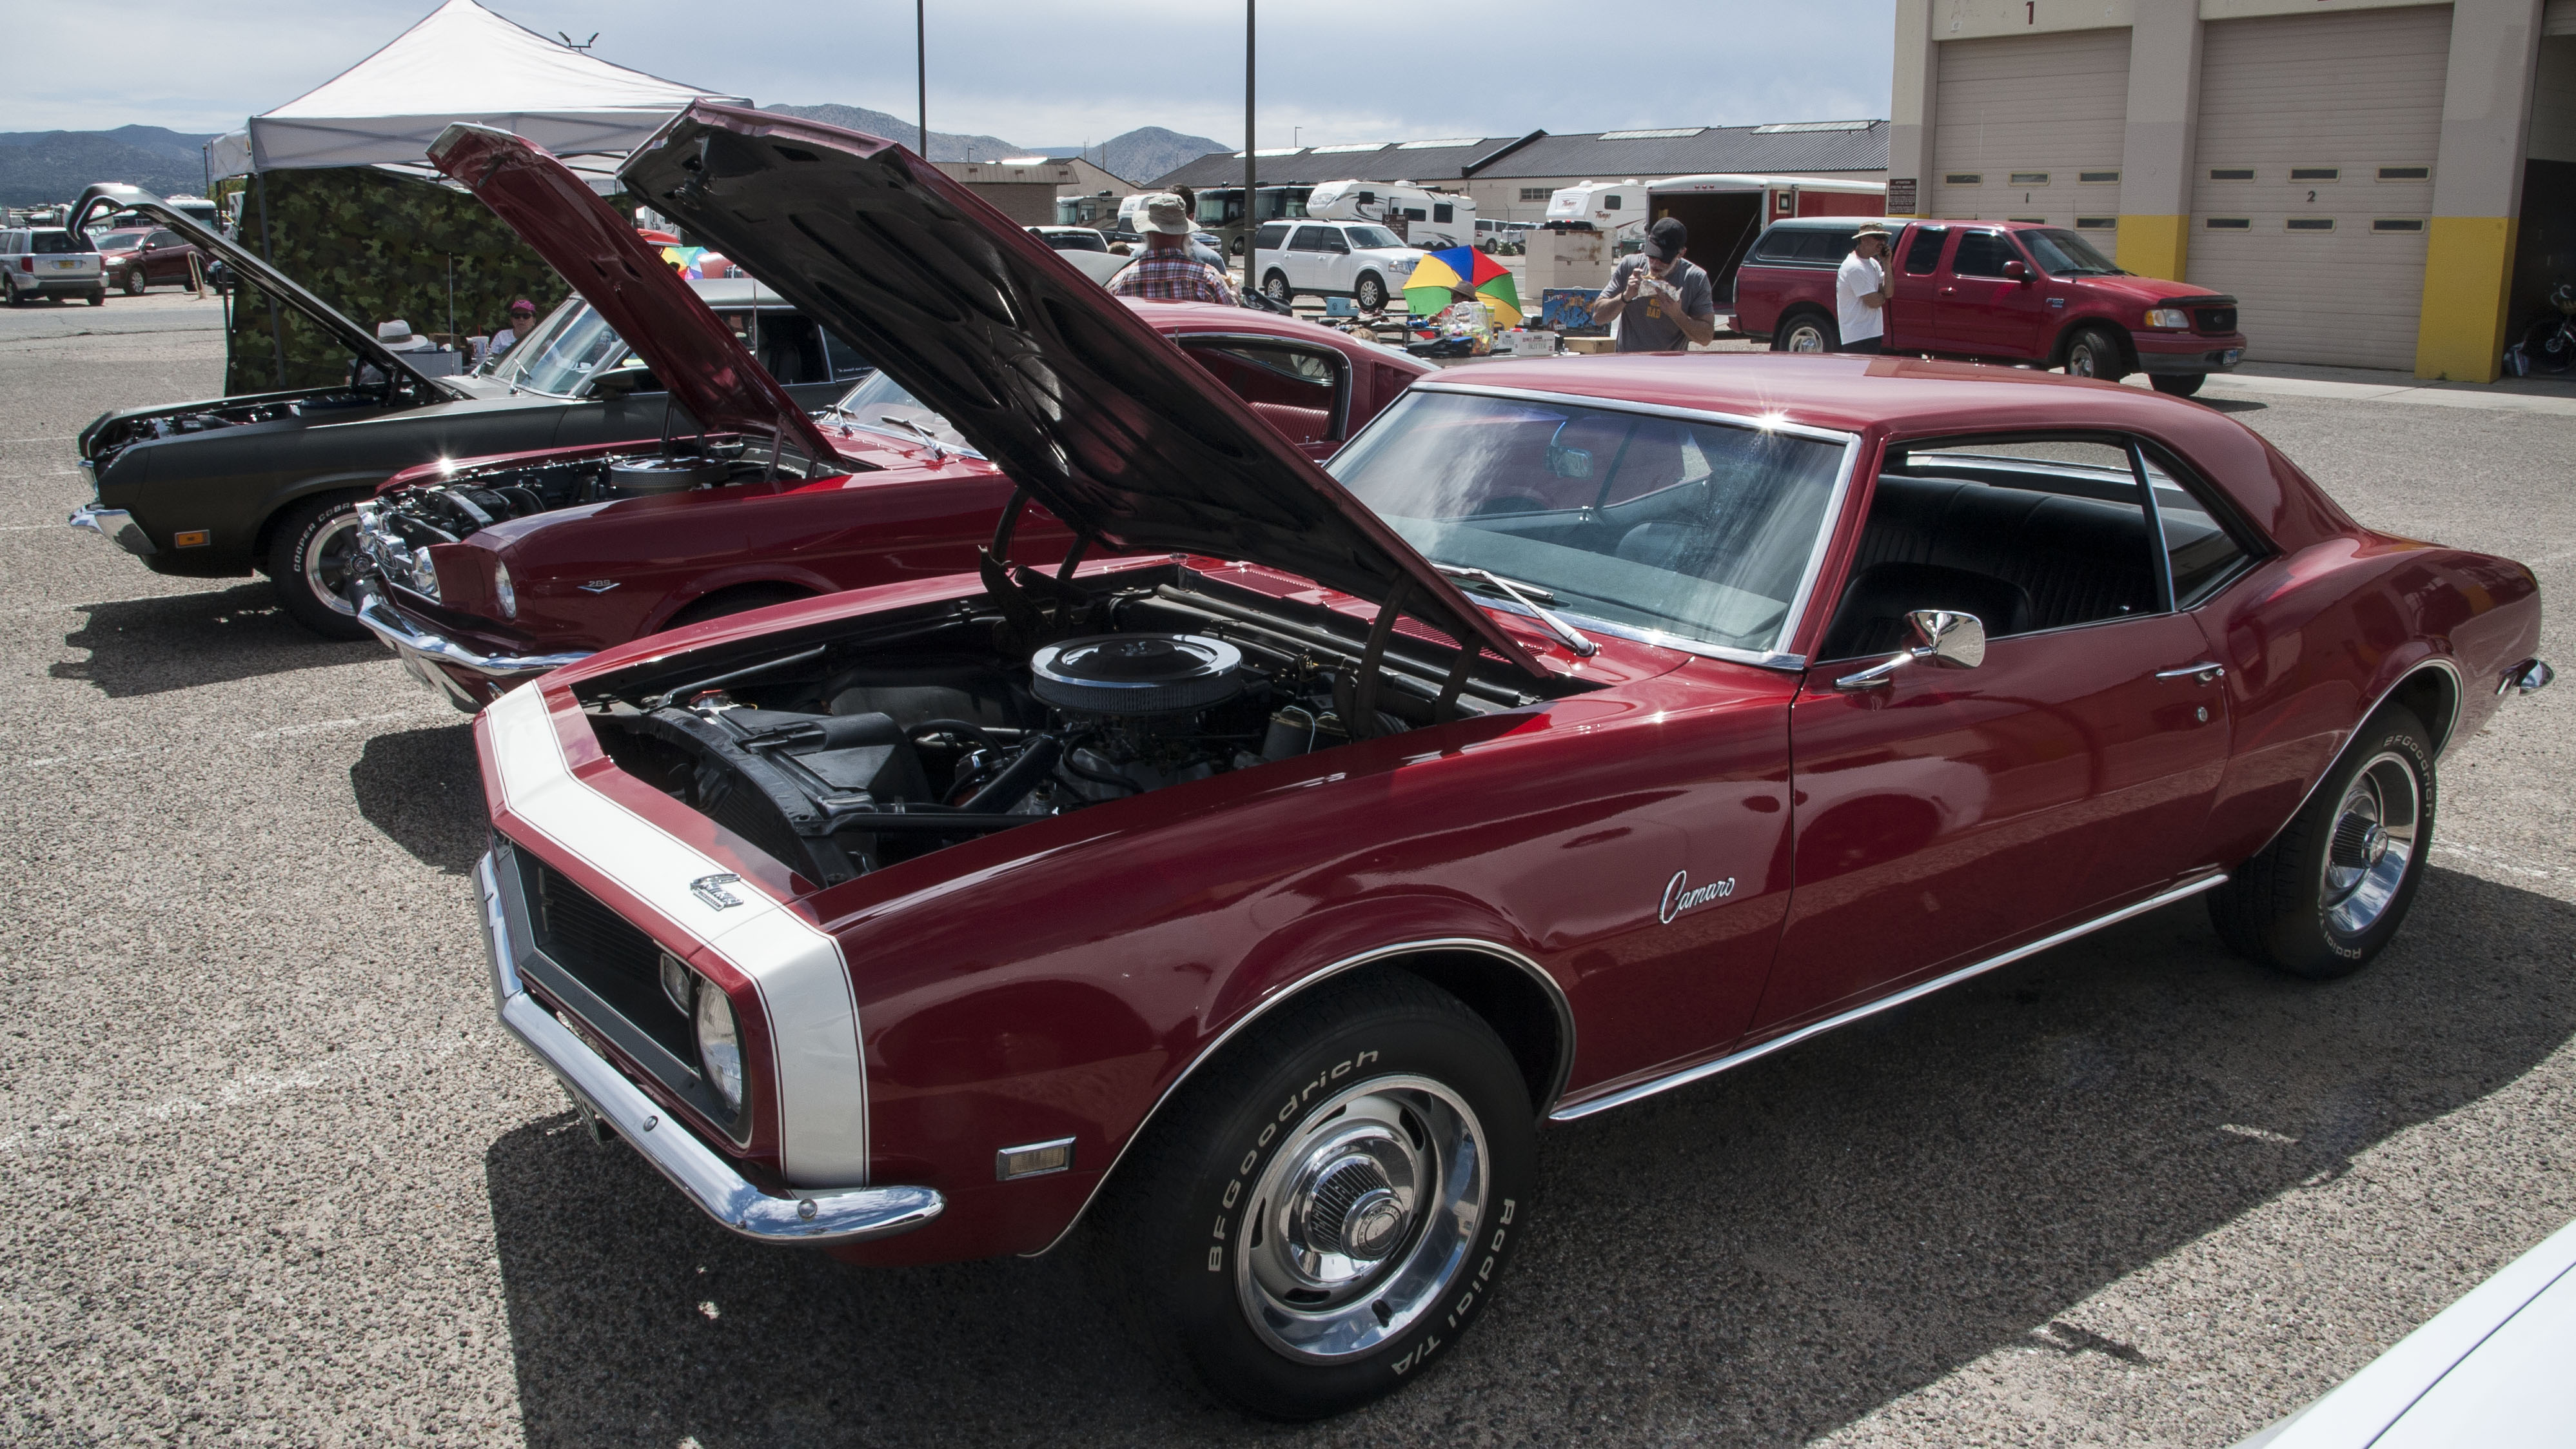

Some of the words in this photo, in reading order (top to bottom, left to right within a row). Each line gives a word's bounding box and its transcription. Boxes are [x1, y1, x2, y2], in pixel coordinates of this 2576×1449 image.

[2025, 1, 2034, 25] 1
[2306, 191, 2315, 202] 2
[293, 522, 316, 572] COOPER
[319, 502, 356, 522] COBR
[1659, 870, 1735, 924] Camaro
[1208, 1049, 1379, 1272] BFGoodrich
[1447, 1198, 1516, 1328] Radial
[1391, 1335, 1441, 1375] T/A
